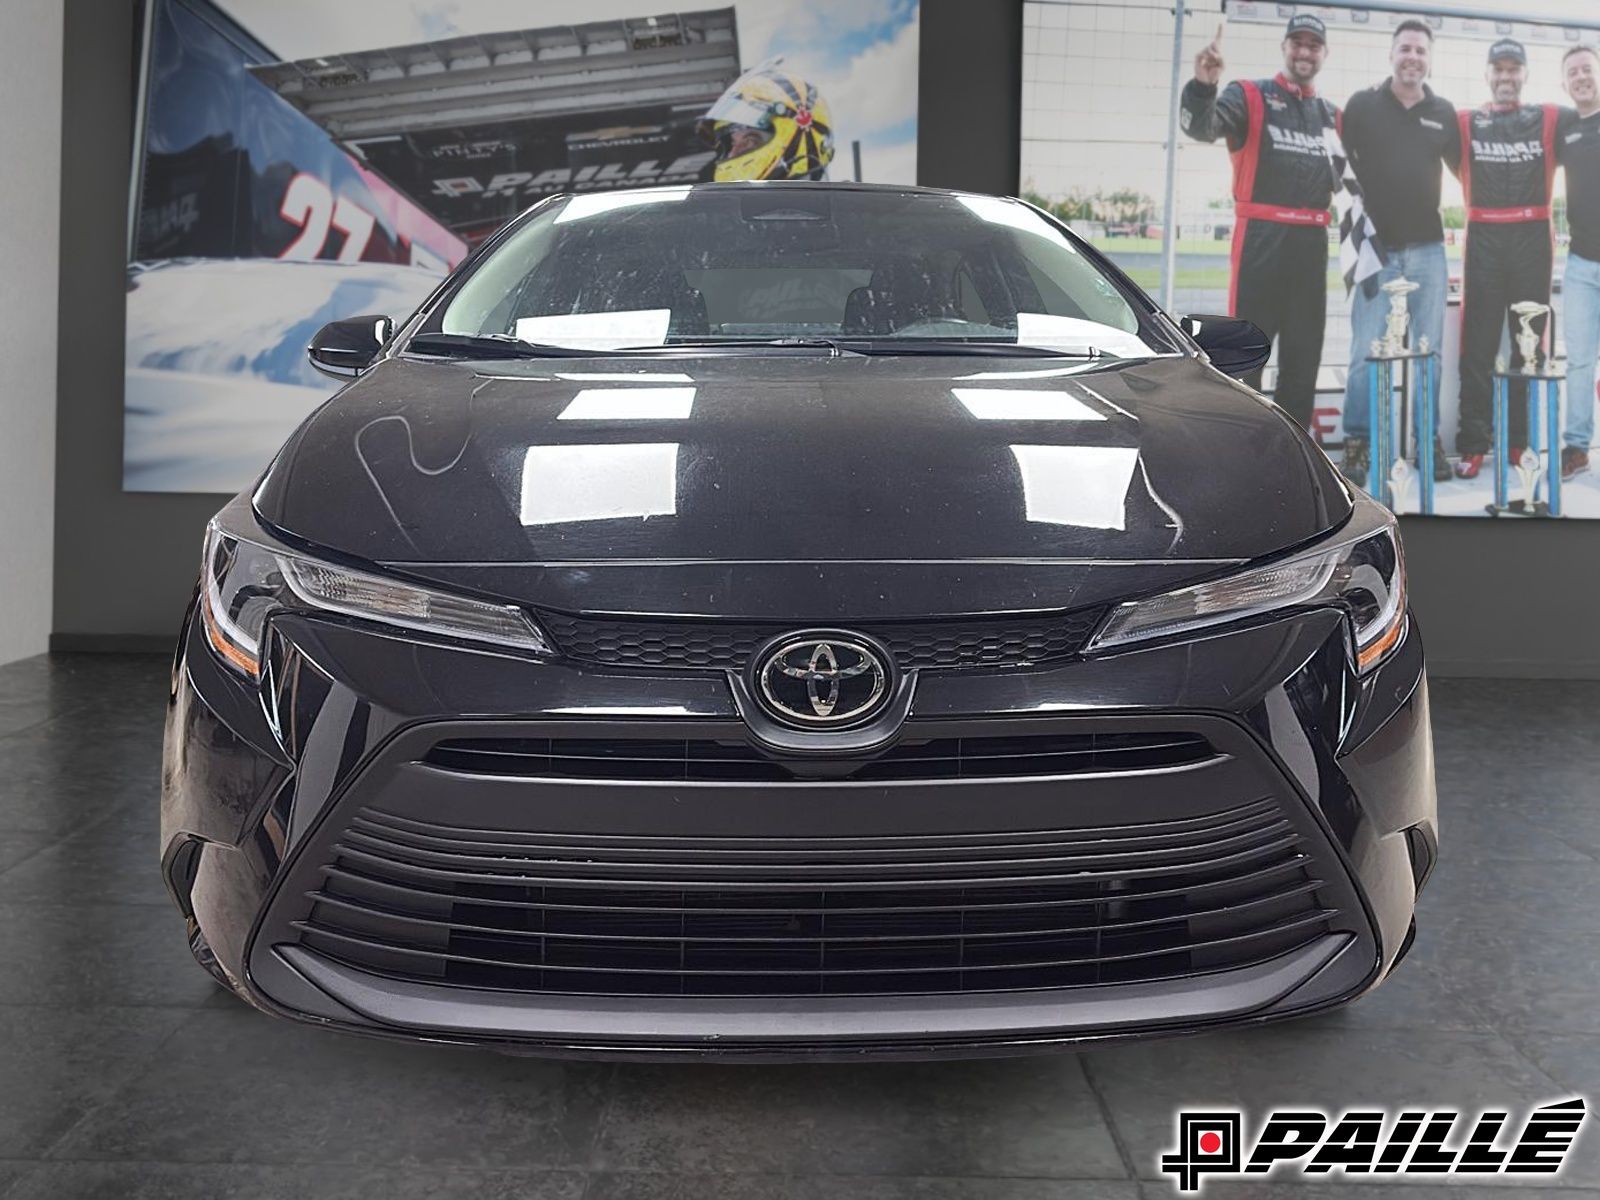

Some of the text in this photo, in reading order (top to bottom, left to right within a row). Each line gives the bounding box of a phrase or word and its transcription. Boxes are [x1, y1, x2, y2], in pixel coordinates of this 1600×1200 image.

[567, 135, 671, 150] CHEVROLET
[574, 173, 700, 190] CANADA
[280, 172, 375, 262] 27
